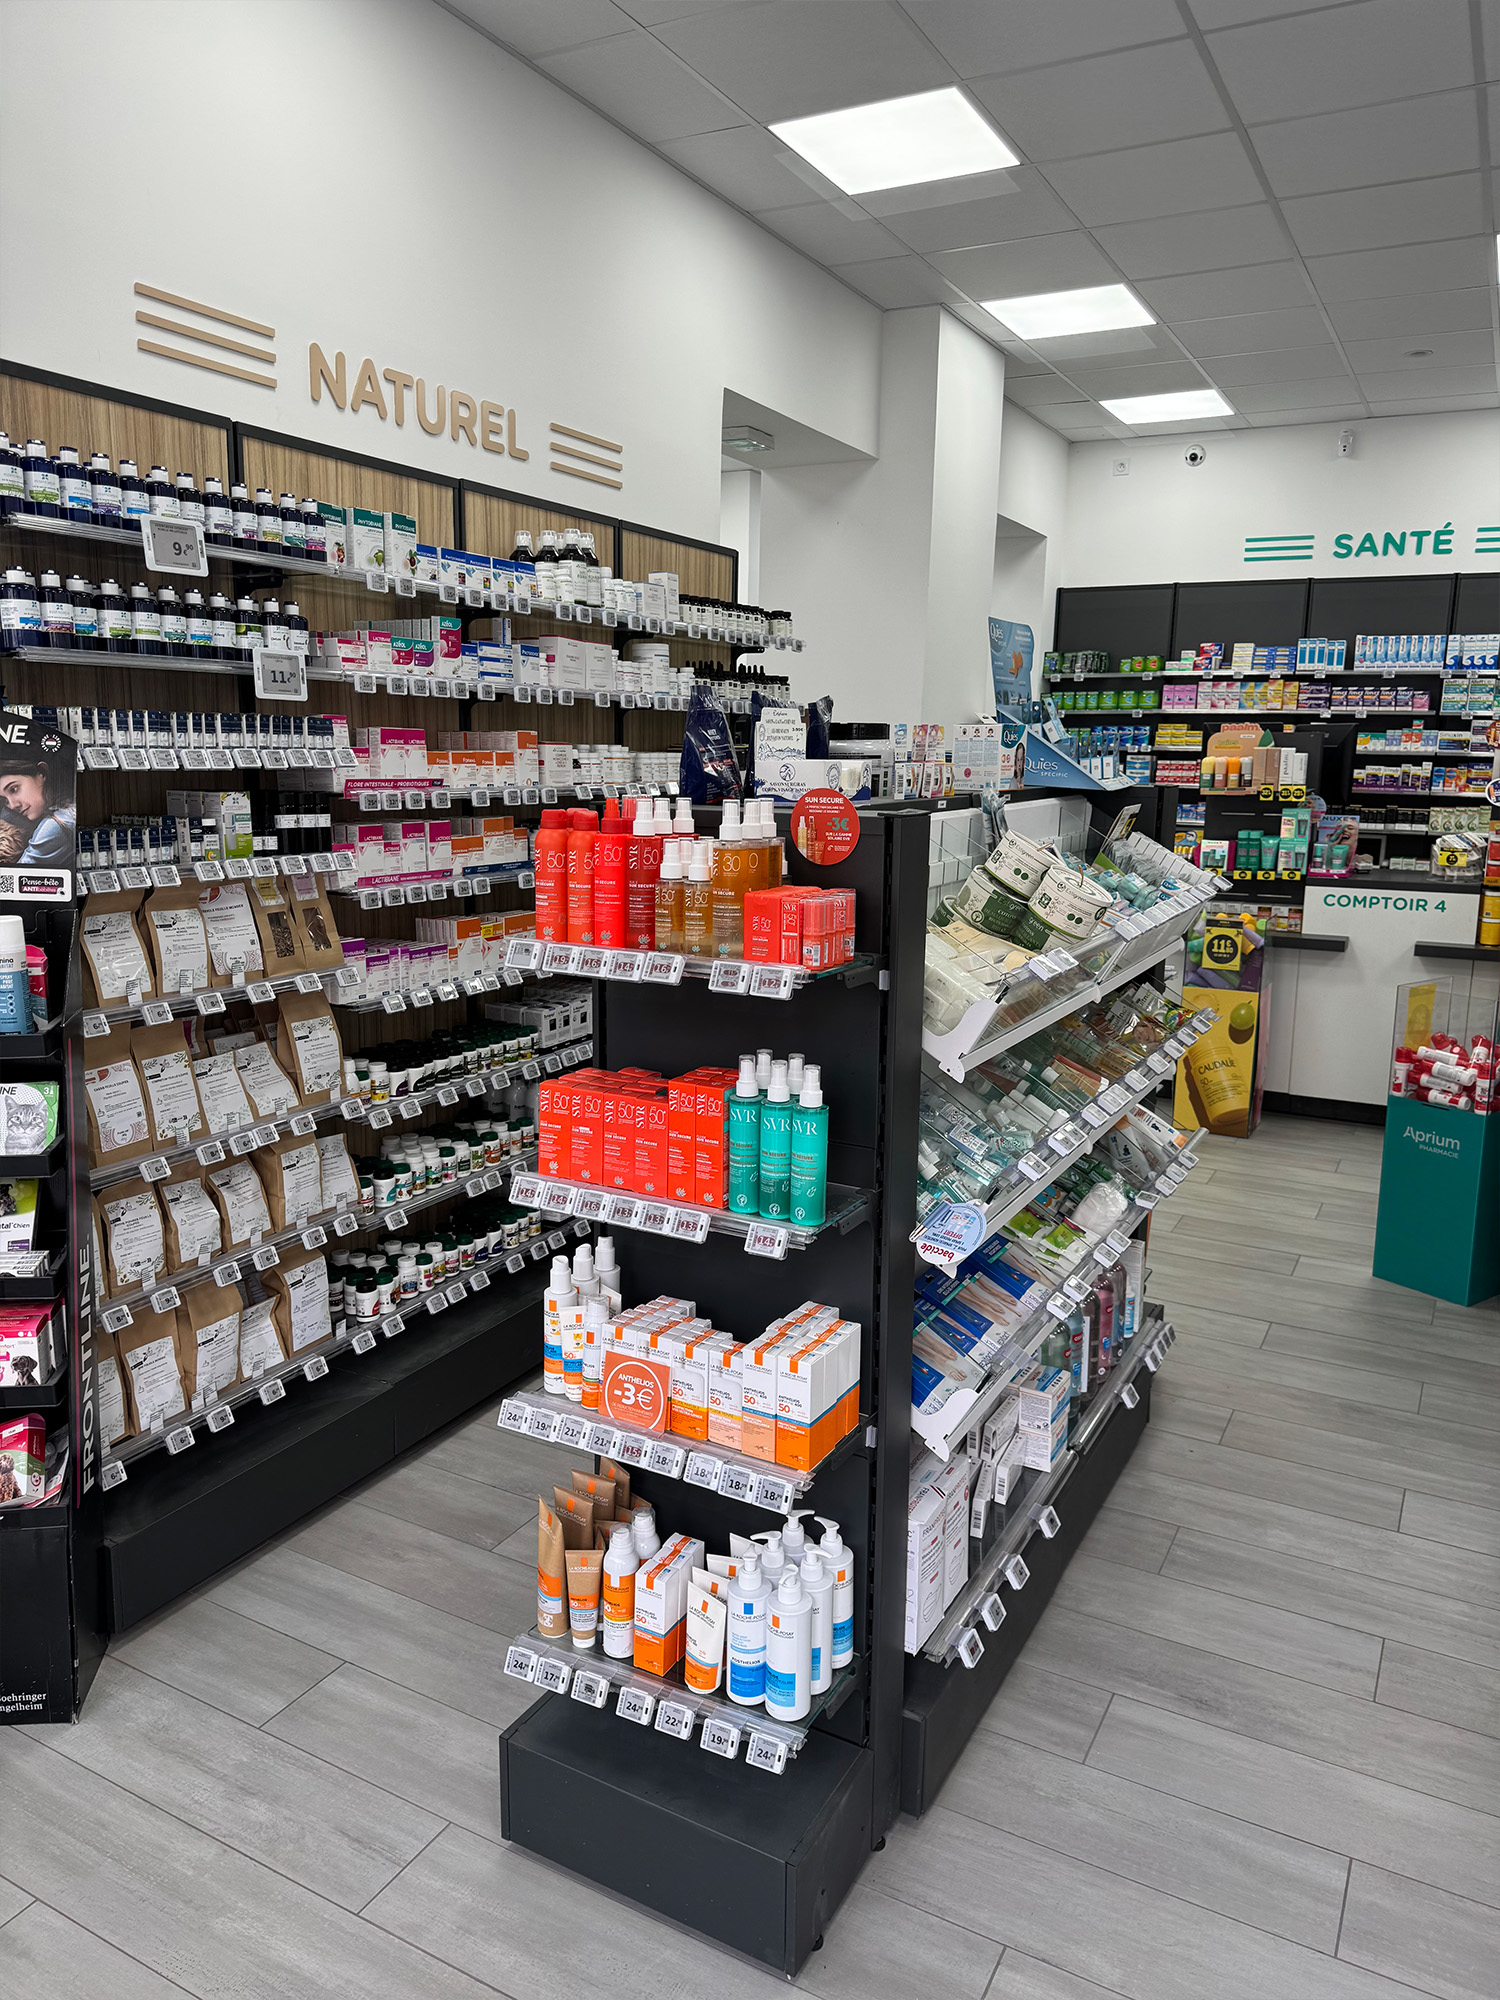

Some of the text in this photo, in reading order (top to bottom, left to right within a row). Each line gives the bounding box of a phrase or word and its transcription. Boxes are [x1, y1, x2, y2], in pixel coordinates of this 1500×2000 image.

[309, 342, 529, 461] NATUREL
[1333, 522, 1454, 559] SANTÉ
[1025, 757, 1059, 771] Quies
[827, 817, 849, 831] -3€
[569, 850, 577, 874] SVR
[629, 845, 638, 869] SVR
[722, 855, 741, 872] 30
[1323, 893, 1447, 913] COMPTOIR 4
[540, 1089, 550, 1112] SVR
[571, 1095, 581, 1118] SVR
[605, 1100, 614, 1124] SVR
[669, 1089, 678, 1112] SVR
[696, 1094, 706, 1116] SVR
[636, 1106, 645, 1129] SVR
[730, 1109, 757, 1123] SVR
[763, 1117, 791, 1132] SVR
[792, 1119, 817, 1136] SVR
[1403, 1126, 1460, 1150] Aprium
[1419, 1144, 1459, 1159] PHARMACIE
[920, 1242, 955, 1262] baccide
[79, 1244, 95, 1494] FRONTLINE
[618, 1373, 655, 1389] ANTHELIOS
[613, 1382, 655, 1410] -3€
